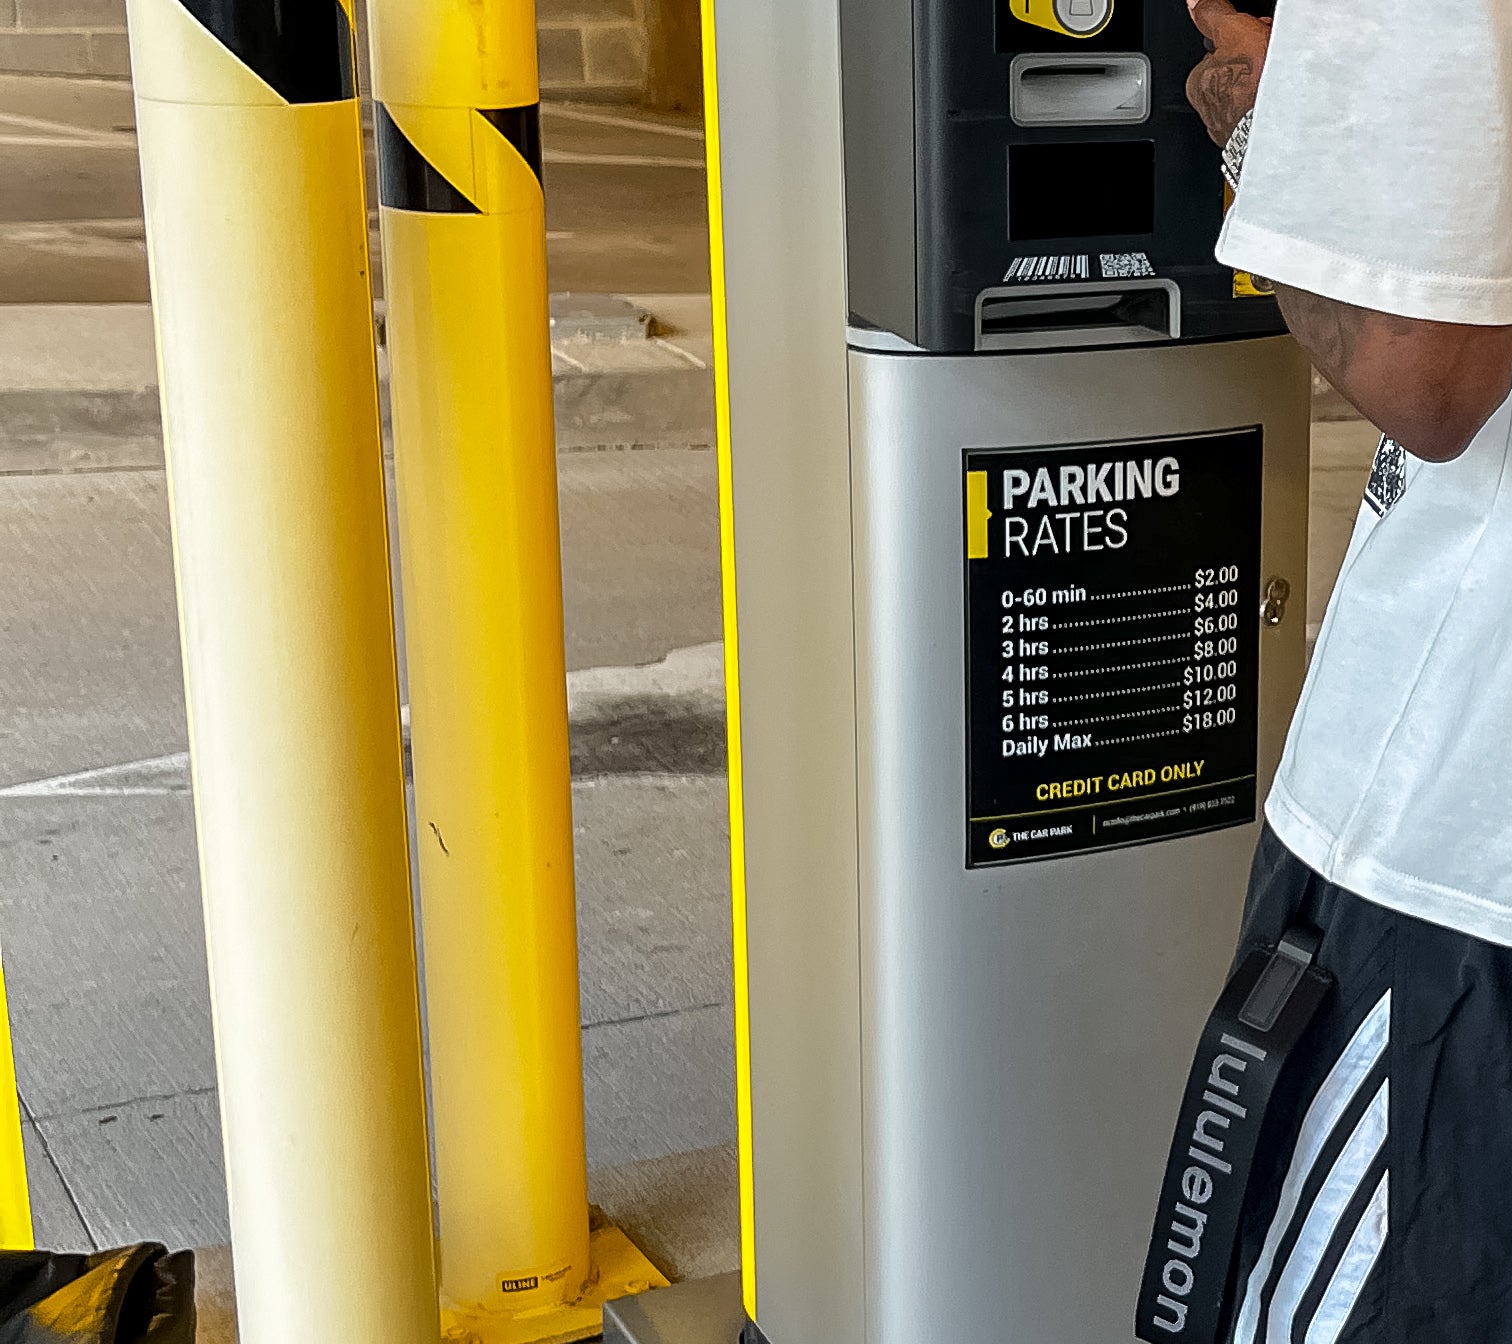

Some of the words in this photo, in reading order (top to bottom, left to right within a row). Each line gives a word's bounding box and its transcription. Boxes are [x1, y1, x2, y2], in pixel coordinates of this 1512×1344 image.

[1003, 456, 1180, 510] PARKING
[1005, 508, 1128, 558] RATES
[1001, 587, 1047, 609] 0-60
[1052, 583, 1087, 605] min
[1195, 564, 1239, 589] $2.00
[1001, 616, 1014, 634] 2
[1019, 613, 1049, 633] hrs
[1194, 589, 1238, 613] $4.00
[1001, 640, 1014, 658] 3
[1019, 638, 1049, 658] hrs
[1194, 612, 1238, 637] $6.00
[1001, 665, 1014, 683] 4
[1019, 662, 1049, 682] hrs
[1194, 636, 1237, 661] $8.00
[1001, 690, 1014, 708] 5
[1019, 688, 1049, 707] hrs
[1183, 660, 1237, 686] $10.00
[1001, 714, 1014, 733] 6
[1019, 712, 1049, 731] hrs
[1182, 683, 1236, 710] $12.00
[1002, 735, 1049, 758] Daily
[1053, 733, 1092, 752] Max
[1182, 707, 1236, 733] $18.00
[1036, 776, 1103, 801] CREDIT
[1107, 768, 1156, 792] CARD
[1160, 760, 1205, 783] ONLY
[1013, 830, 1029, 842] THE
[1030, 829, 1049, 839] CAR
[1050, 824, 1073, 836] PARK
[1153, 1032, 1268, 1335] lululemon
